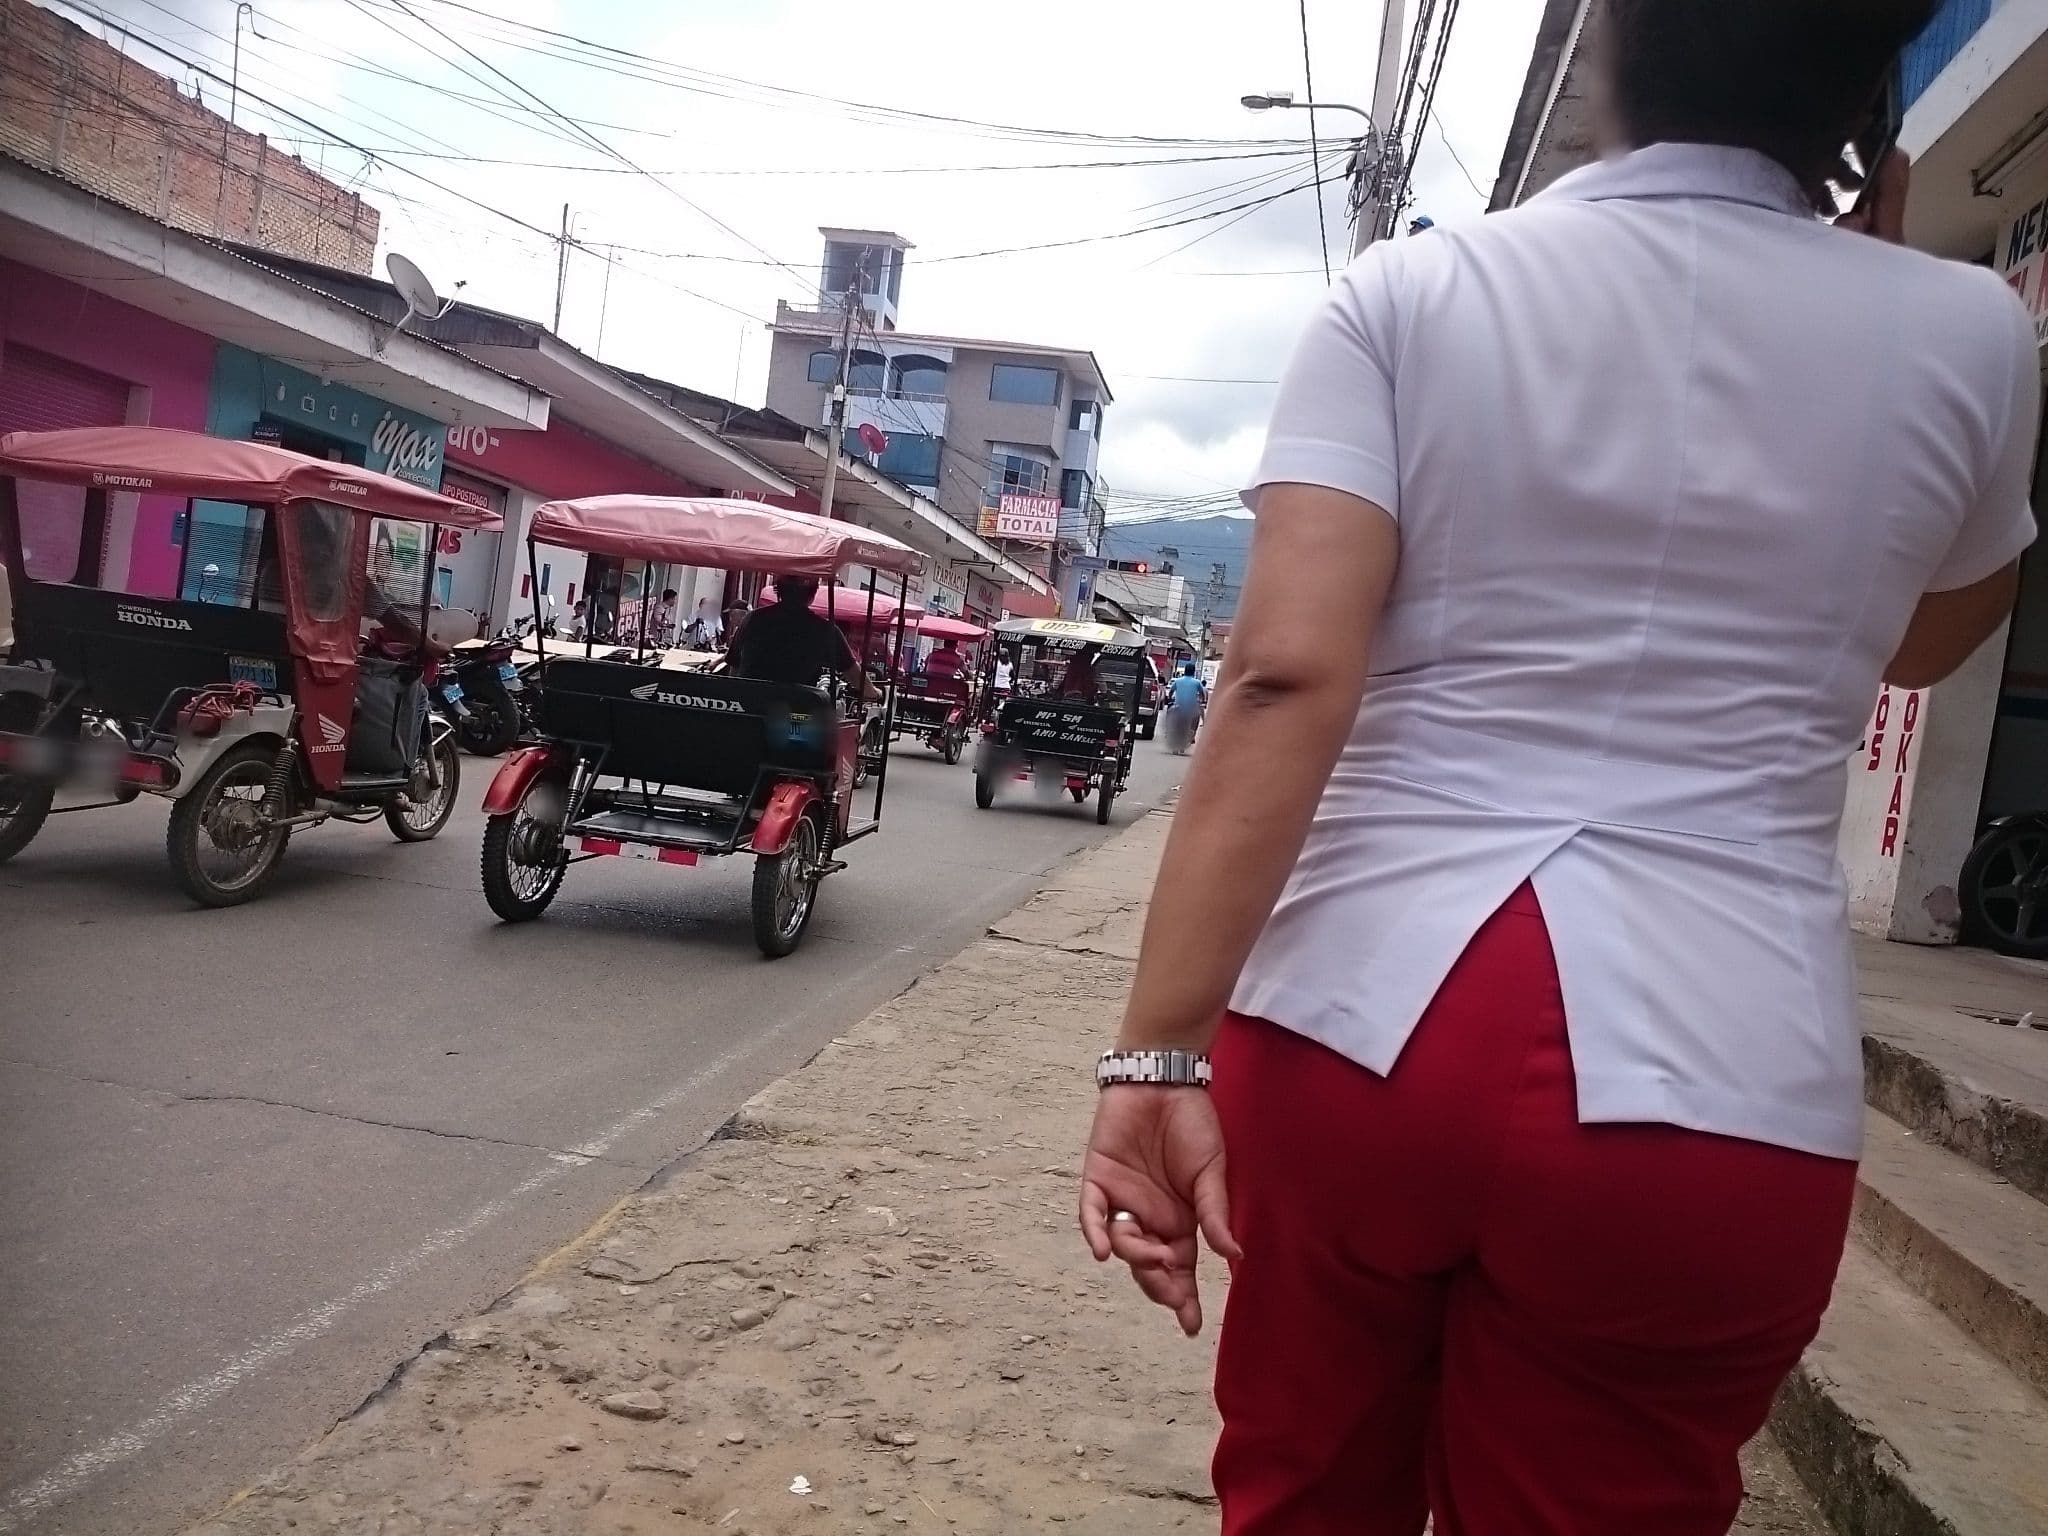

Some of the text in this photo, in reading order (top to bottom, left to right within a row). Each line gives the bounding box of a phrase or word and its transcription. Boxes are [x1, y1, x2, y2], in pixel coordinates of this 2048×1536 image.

[105, 475, 152, 488] MOTOKAR
[336, 483, 368, 496] MOTOKAR
[456, 488, 488, 508] POSTPAGO
[1000, 496, 1057, 518] FARMACIA
[1002, 517, 1054, 533] TOTAL
[117, 604, 152, 614] POWERED
[117, 611, 192, 631] HONDA
[656, 691, 746, 713] HONDA
[1035, 711, 1083, 723] MP SM
[311, 743, 346, 754] HONDA
